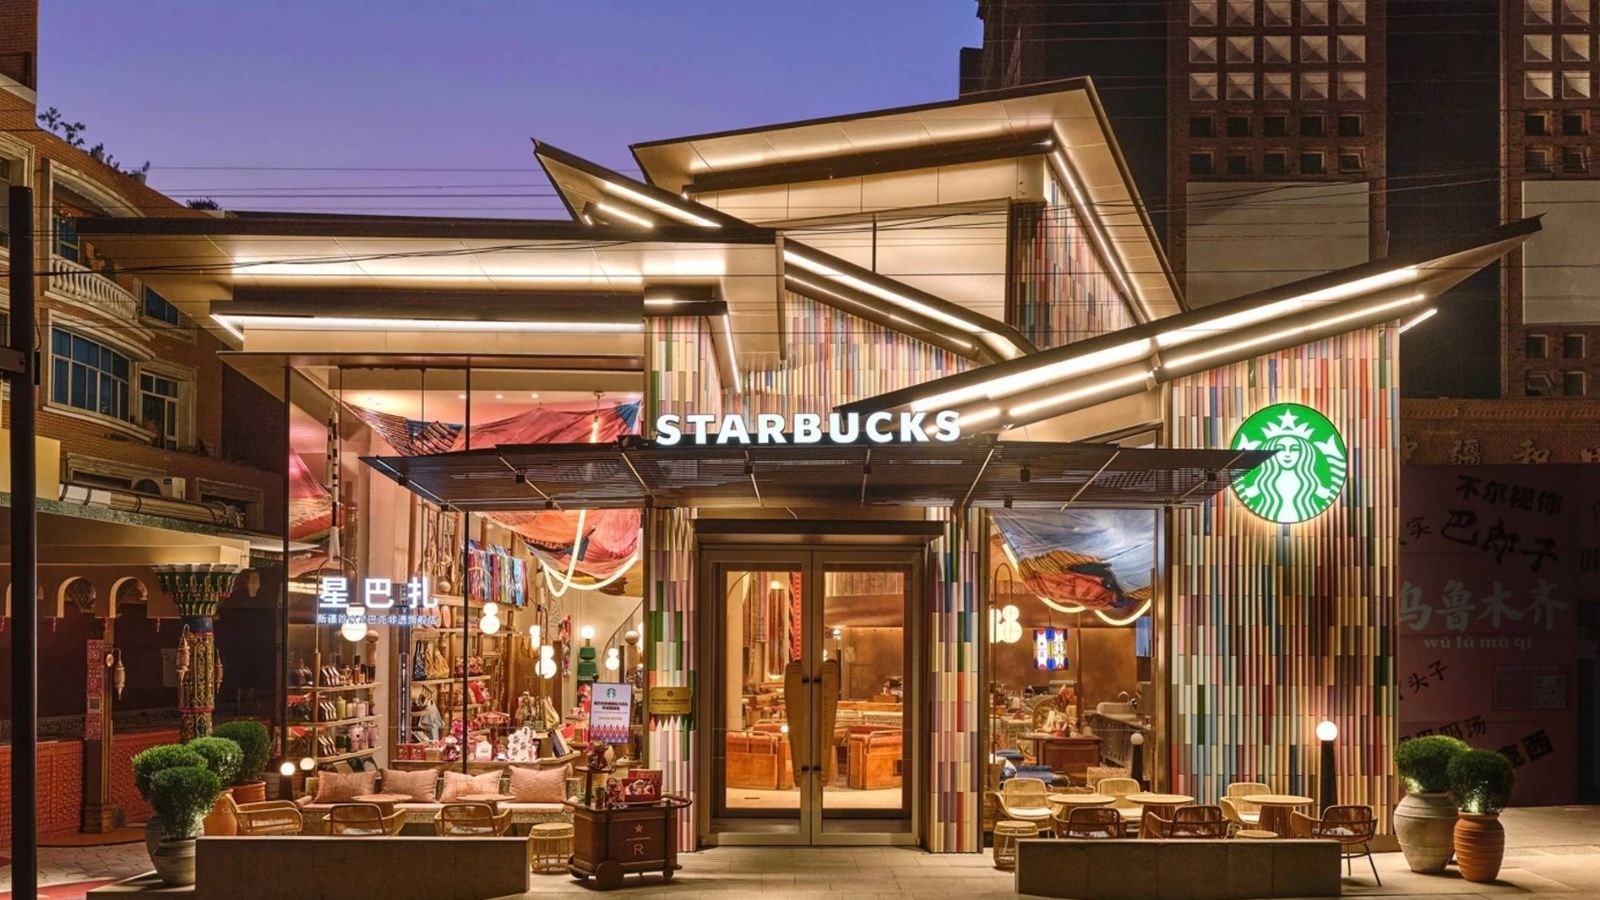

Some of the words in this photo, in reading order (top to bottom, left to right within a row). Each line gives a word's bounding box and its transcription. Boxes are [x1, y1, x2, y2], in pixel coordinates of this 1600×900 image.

[655, 411, 961, 446] STARBUCKS
[319, 576, 438, 609] 星巴扎
[1400, 578, 1568, 632] 乌鲁木齐
[1401, 660, 1447, 698] 头子
[633, 843, 645, 856] R
